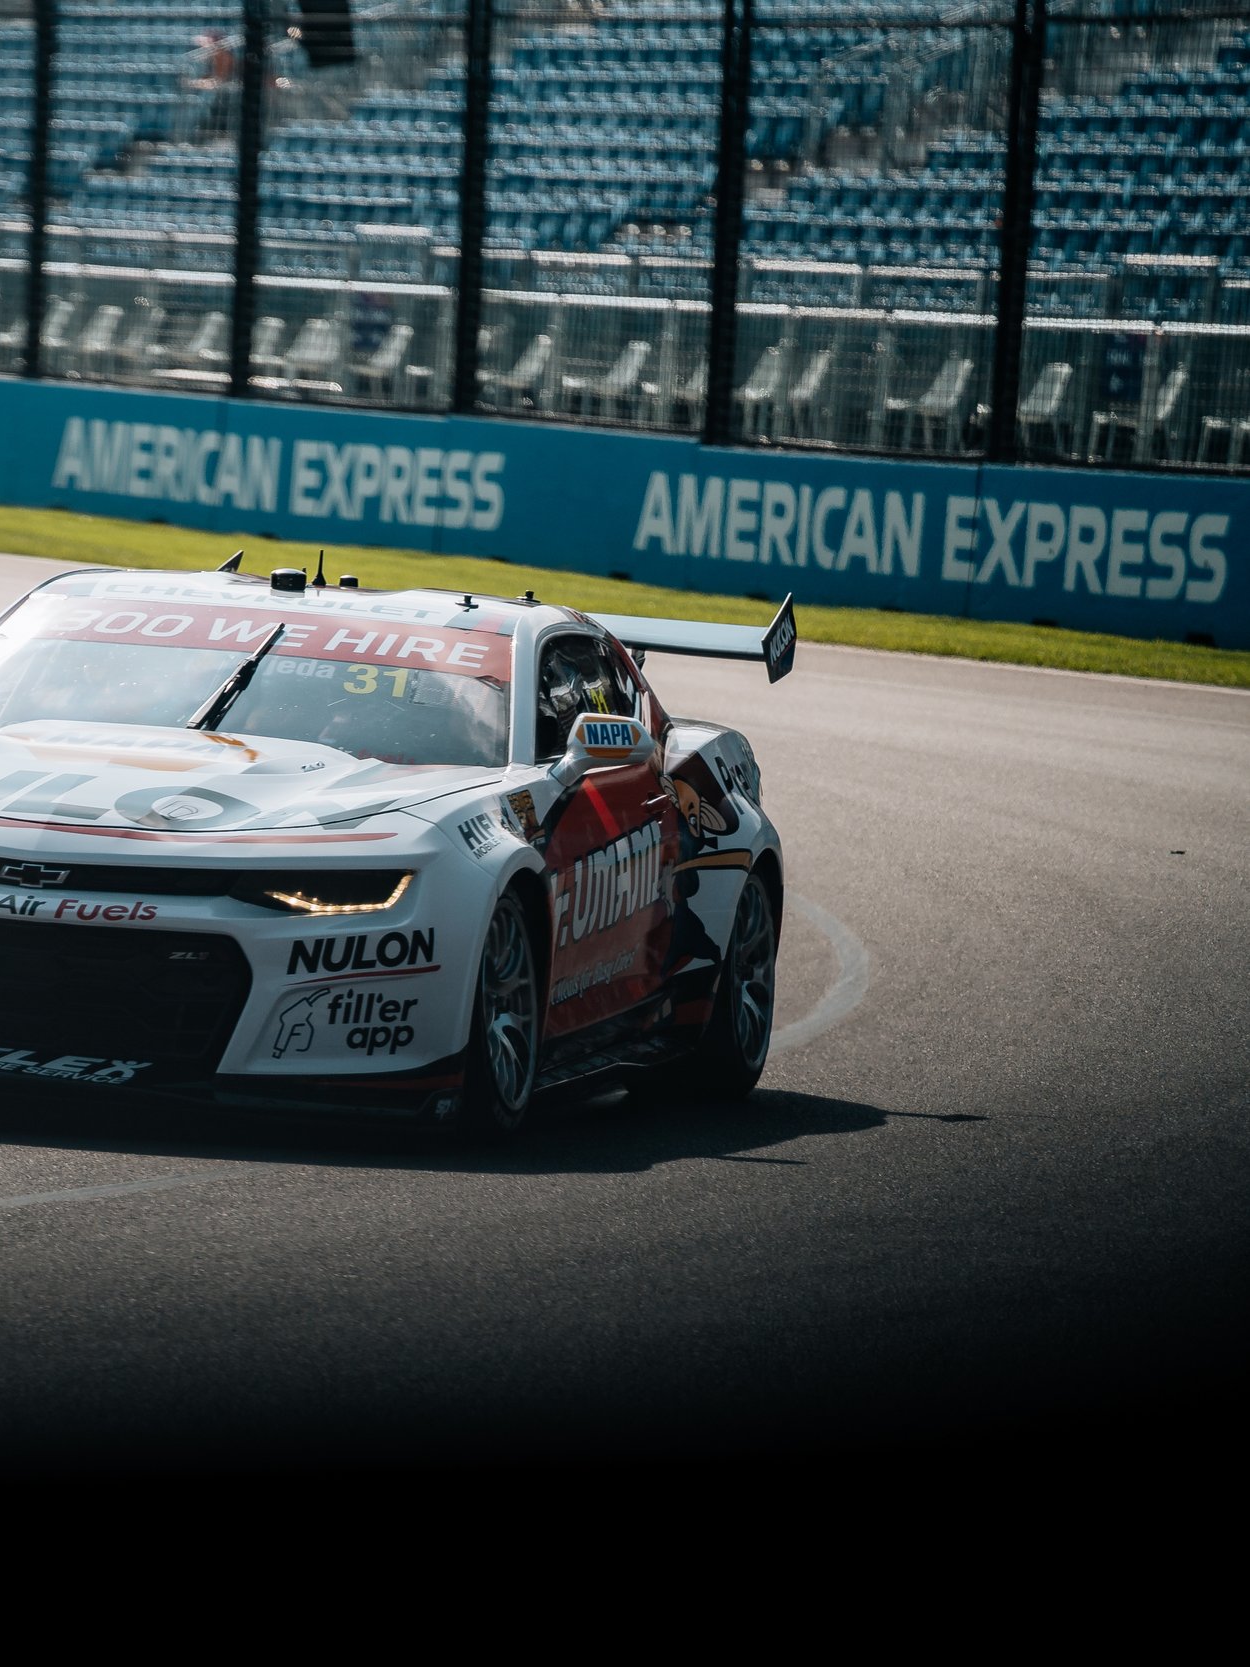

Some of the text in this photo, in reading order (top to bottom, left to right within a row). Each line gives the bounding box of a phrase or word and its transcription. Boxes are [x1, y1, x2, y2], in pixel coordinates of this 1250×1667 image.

[52, 416, 507, 532] AMERICAN EXPRESS
[633, 470, 1230, 603] AMERICAN EXPRESS
[208, 617, 318, 649] WE
[323, 628, 489, 669] HIRE
[770, 612, 795, 667] NULON
[262, 654, 336, 680] jeda
[343, 663, 410, 698] 31
[586, 724, 632, 746] NAPA
[572, 822, 662, 941] UMAMI
[54, 899, 158, 921] Fuels
[287, 928, 434, 975] NULON
[346, 1025, 414, 1056] app
[21, 1066, 130, 1085] SERVICE
